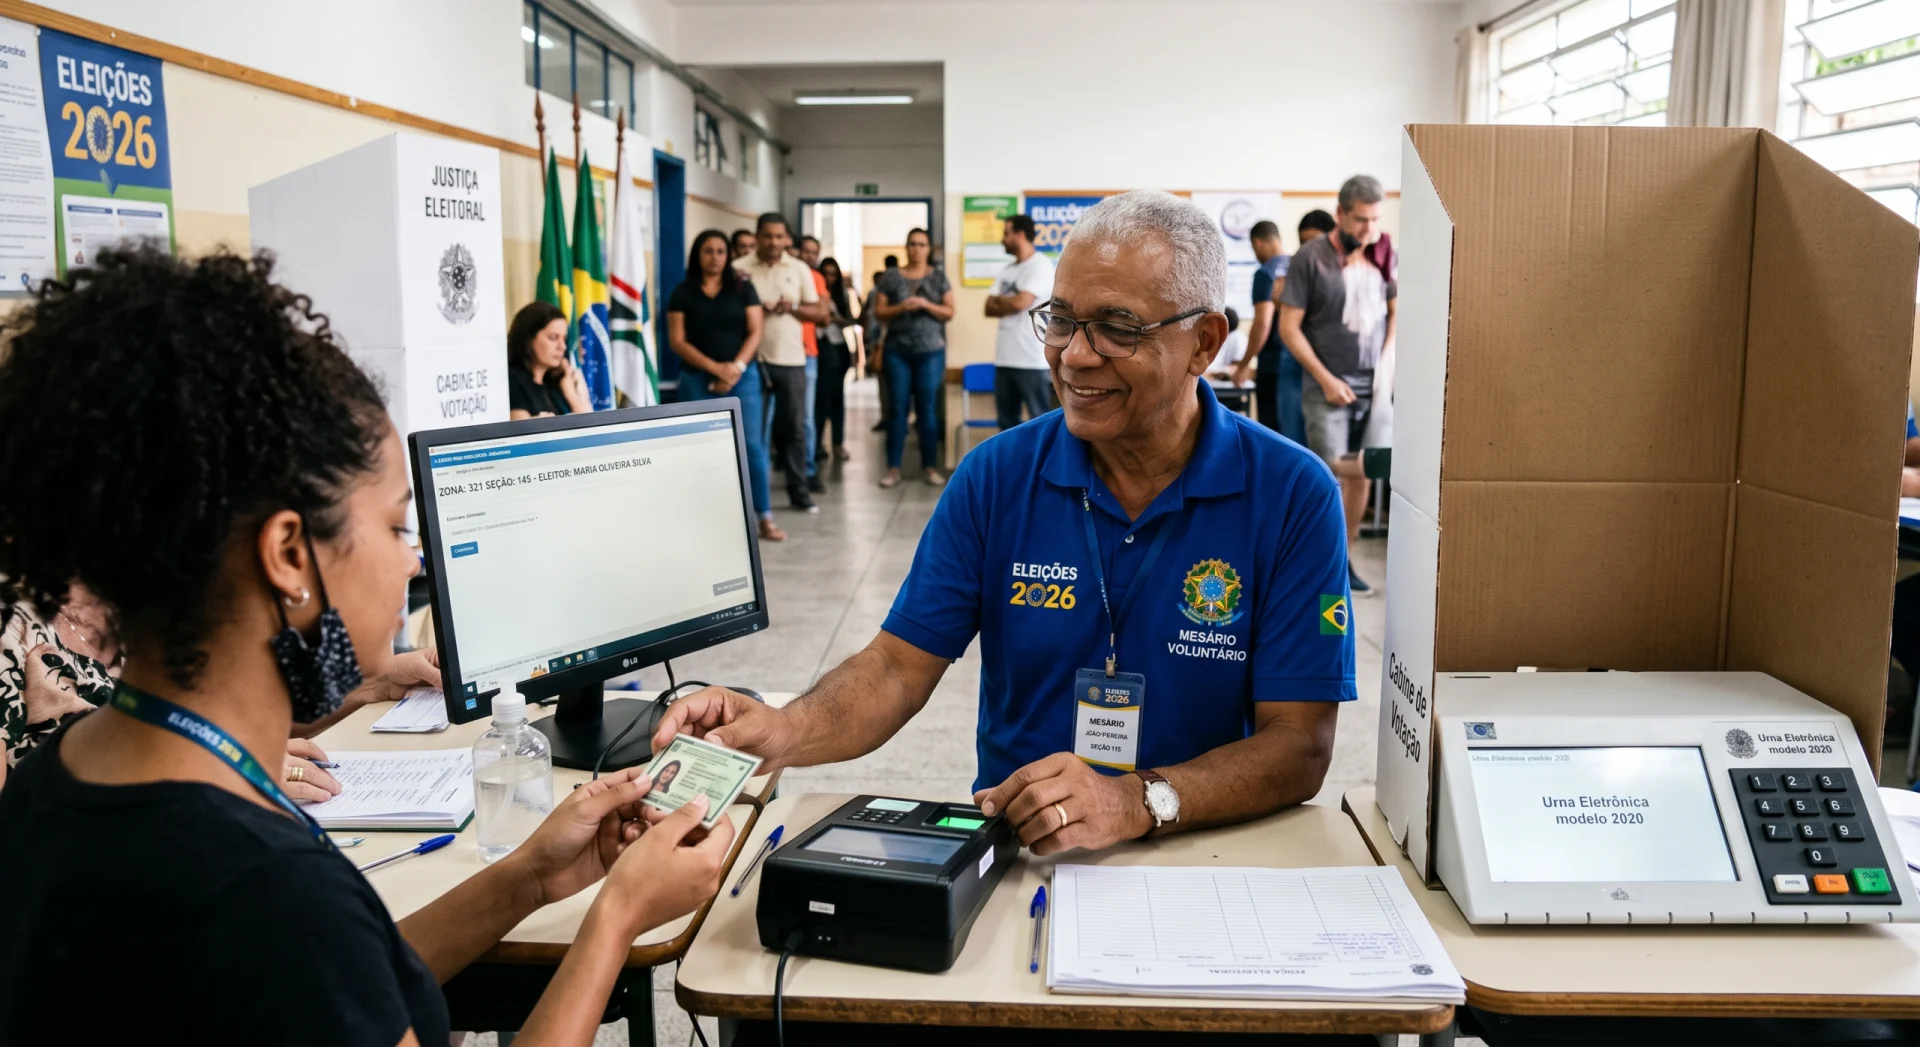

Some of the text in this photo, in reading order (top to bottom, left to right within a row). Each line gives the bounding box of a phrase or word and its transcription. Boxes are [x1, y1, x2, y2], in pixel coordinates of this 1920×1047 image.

[56, 54, 153, 108] ELEIÇÕES
[61, 101, 157, 169] 2026
[432, 165, 479, 195] JUSTIÇA
[425, 196, 486, 221] ELEITORAL
[1033, 223, 1073, 246] 202
[436, 369, 488, 394] CABINE DE
[440, 392, 488, 420] VOTAÇÃO
[438, 485, 467, 497] ZONA:
[468, 482, 484, 493] 321
[485, 476, 516, 491] SEÇÃO:
[517, 475, 531, 485] 145
[538, 470, 572, 482] ELEITOR:
[573, 465, 598, 476] MARIA
[598, 460, 631, 472] OLIVEIRA
[632, 457, 652, 468] SILVA
[1012, 562, 1078, 582] ELEIÇÕES
[1009, 581, 1076, 610] 2026
[1179, 629, 1237, 646] MESÁRIO
[1167, 643, 1247, 661] VOLUNTÁRIO
[1389, 652, 1427, 719] Cabine de
[1105, 694, 1130, 704] 2026
[1089, 717, 1125, 728] MESÁRIO
[1391, 699, 1421, 763] Votação
[1757, 733, 1836, 742] Urna Eletrônica
[1090, 743, 1110, 751] SEÇÃO
[1769, 745, 1833, 754] modelo 2020
[1754, 776, 1761, 786] 1
[1787, 776, 1797, 786] 2
[1822, 776, 1832, 786] 3
[1542, 795, 1650, 808] Urna Eletrônica
[1761, 800, 1770, 811] 4
[1796, 800, 1805, 811] 5
[1831, 800, 1840, 811] 6
[1555, 812, 1644, 824] modelo 2020
[1768, 825, 1777, 836] 7
[1803, 825, 1813, 836] 8
[1839, 825, 1849, 836] 9
[1812, 850, 1822, 861] 0
